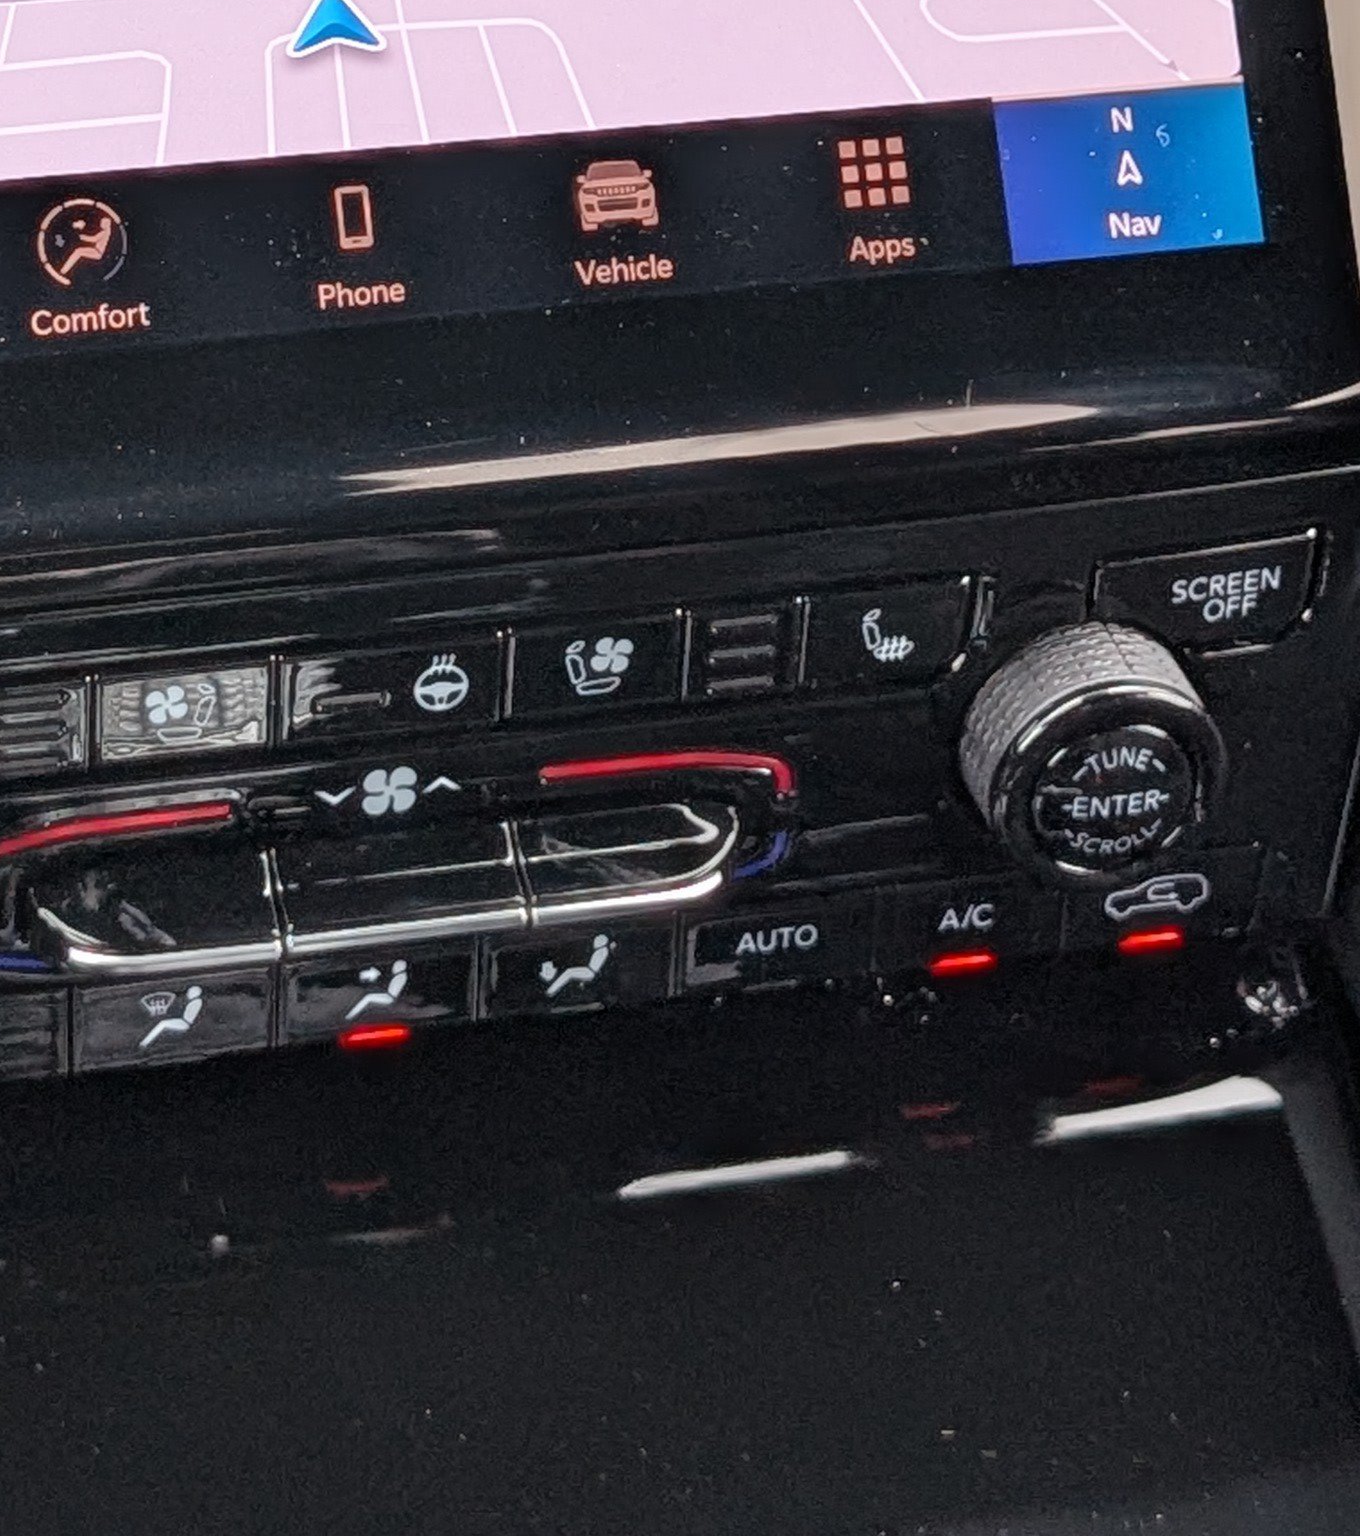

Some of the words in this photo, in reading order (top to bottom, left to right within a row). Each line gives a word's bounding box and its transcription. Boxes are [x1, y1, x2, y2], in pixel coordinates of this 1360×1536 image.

[1111, 107, 1134, 132] N
[1108, 212, 1162, 238] Nav
[849, 235, 915, 265] Apps
[575, 254, 674, 286] Vehicle
[317, 279, 406, 310] Phone
[30, 302, 151, 337] Comfort
[1171, 566, 1283, 603] SCREEN
[1203, 593, 1258, 623] OFF
[1084, 745, 1152, 775] TUNE
[938, 902, 996, 931] A/C
[736, 923, 819, 955] AUTO
